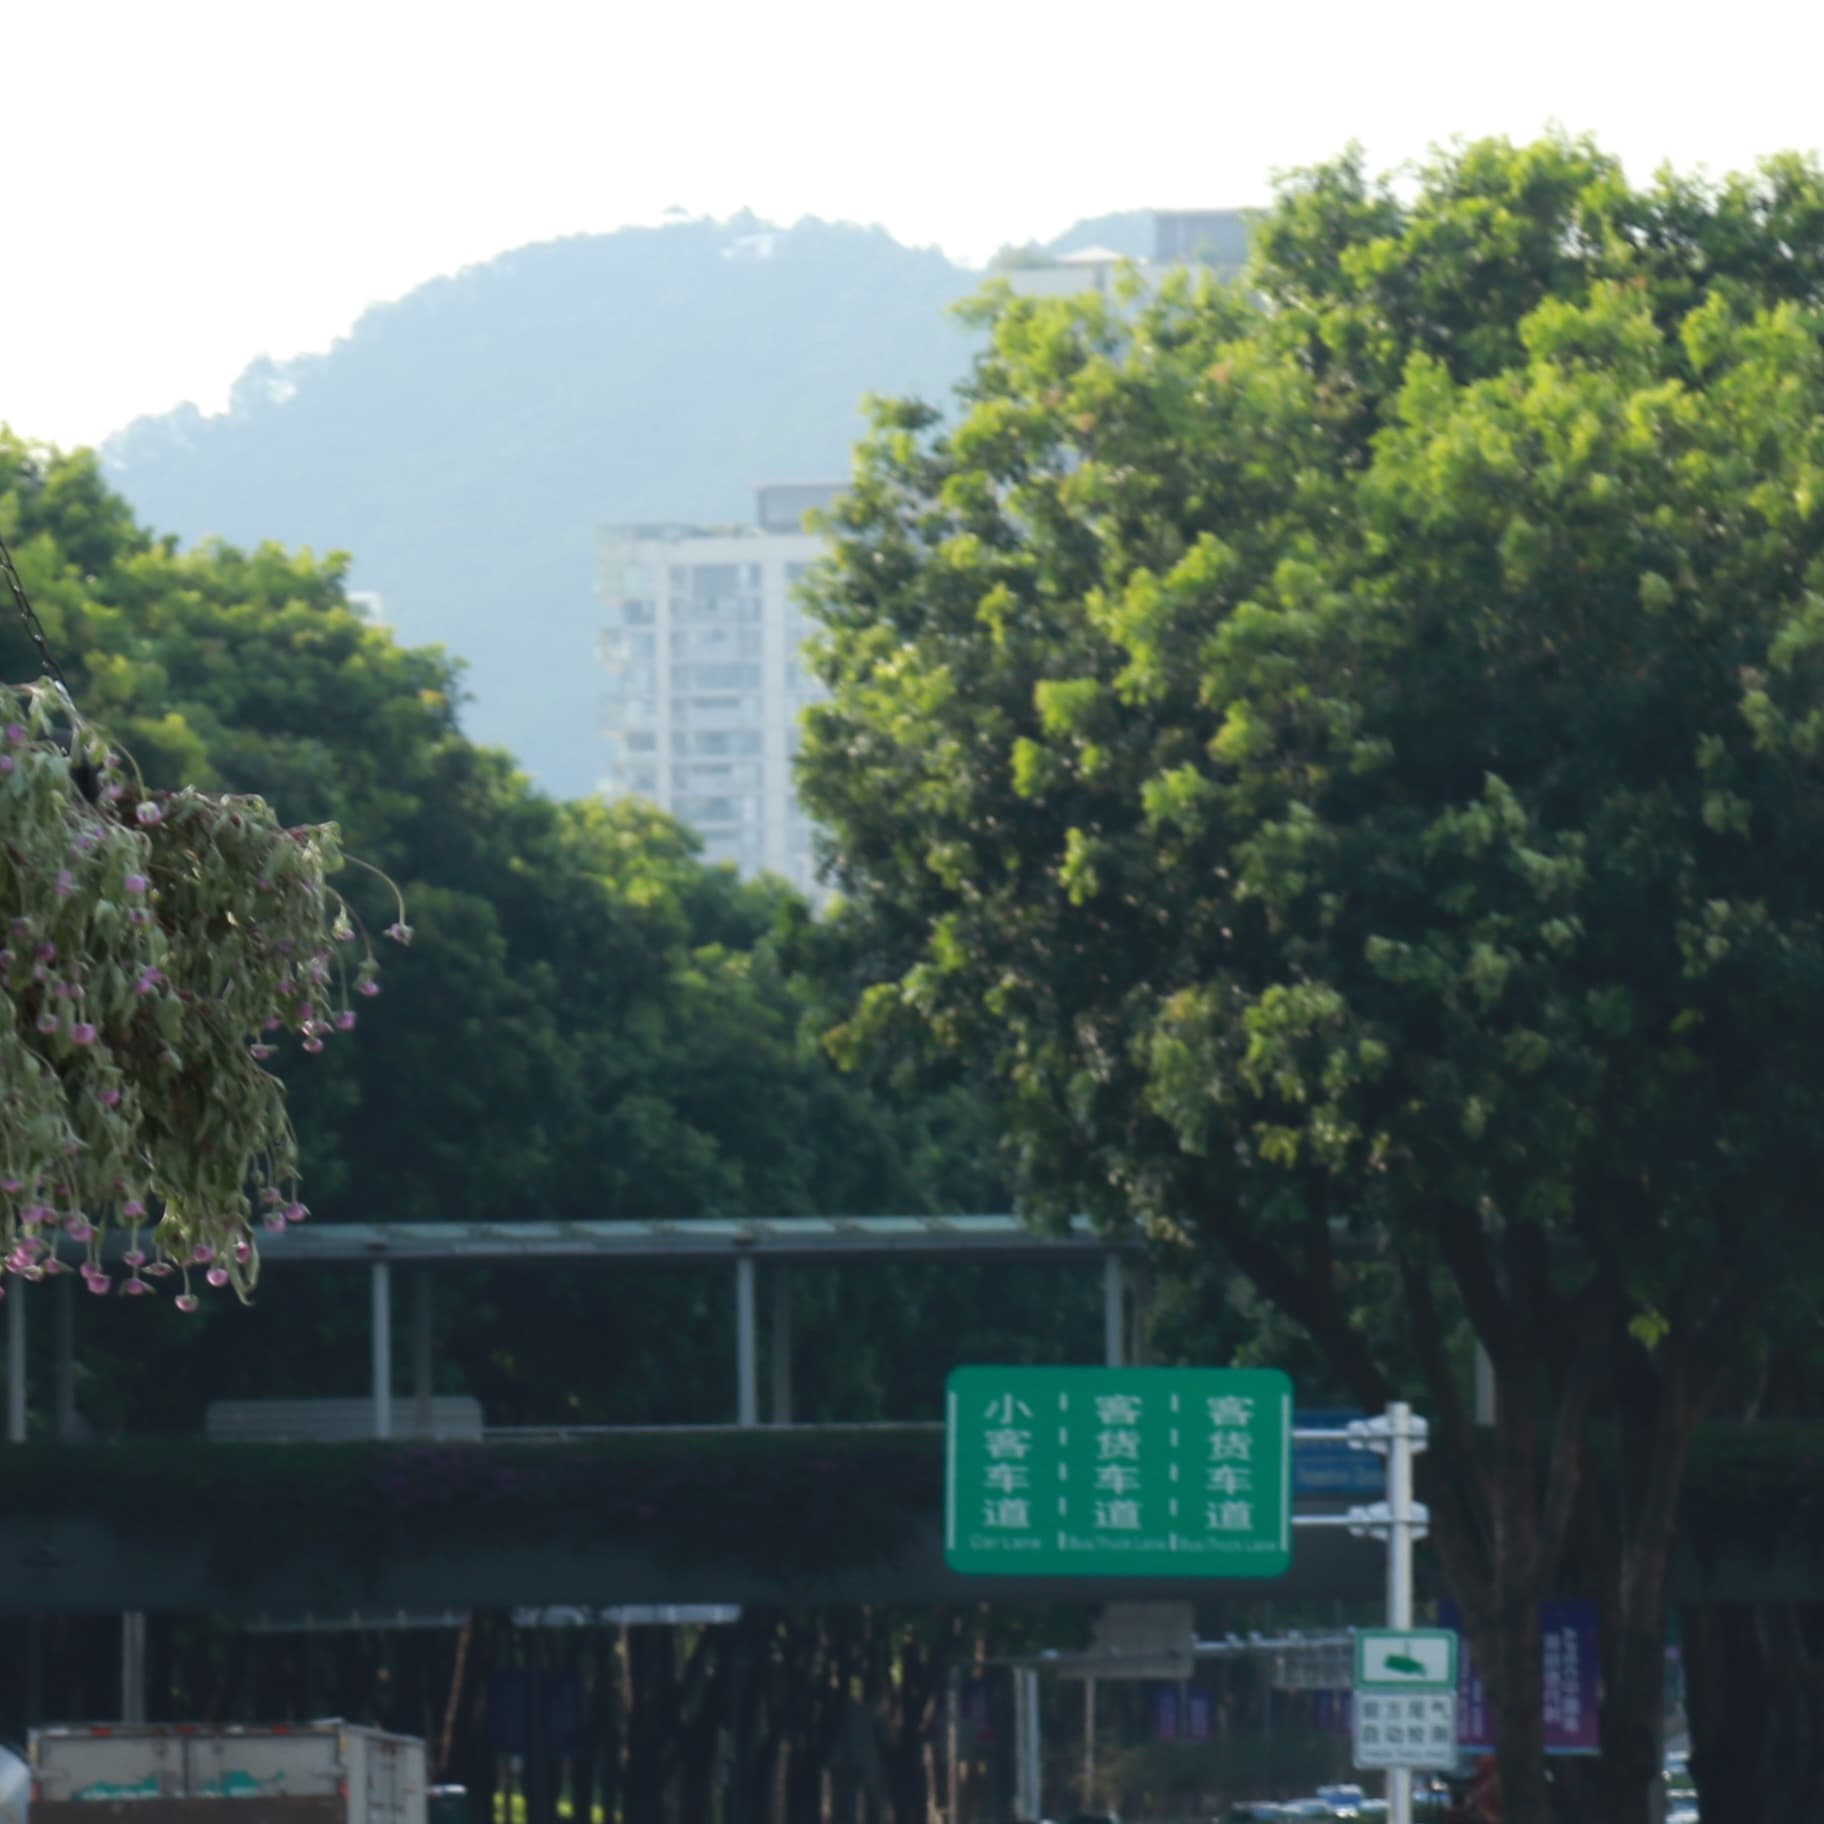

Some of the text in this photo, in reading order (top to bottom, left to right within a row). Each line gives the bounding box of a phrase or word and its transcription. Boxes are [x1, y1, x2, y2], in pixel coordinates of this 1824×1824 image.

[983, 1393, 1033, 1528] 小客车道
[1094, 1394, 1143, 1530] 客货车道
[1205, 1394, 1254, 1531] 客货车道
